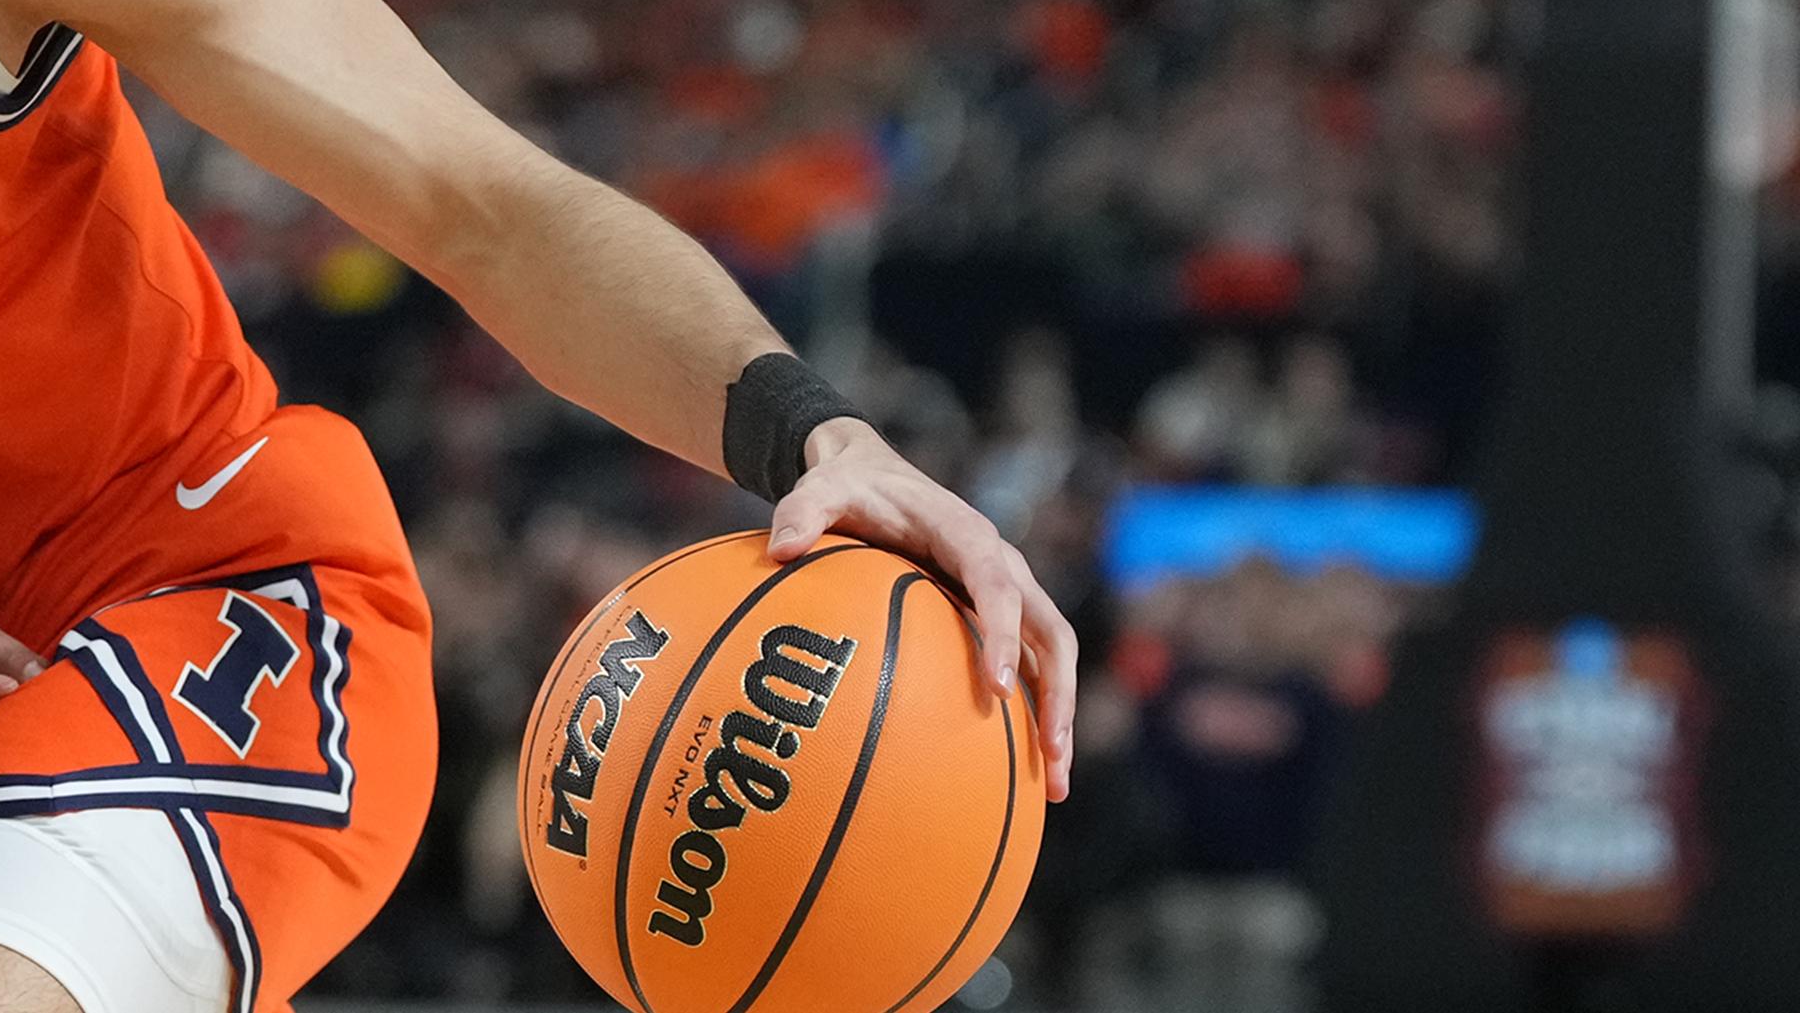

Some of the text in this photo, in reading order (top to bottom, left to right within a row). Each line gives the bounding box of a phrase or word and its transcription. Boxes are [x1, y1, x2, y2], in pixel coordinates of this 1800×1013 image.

[171, 589, 301, 760] I
[546, 607, 672, 858] NCAA
[663, 714, 713, 819] EVO NXT
[647, 623, 859, 948] Wilson
